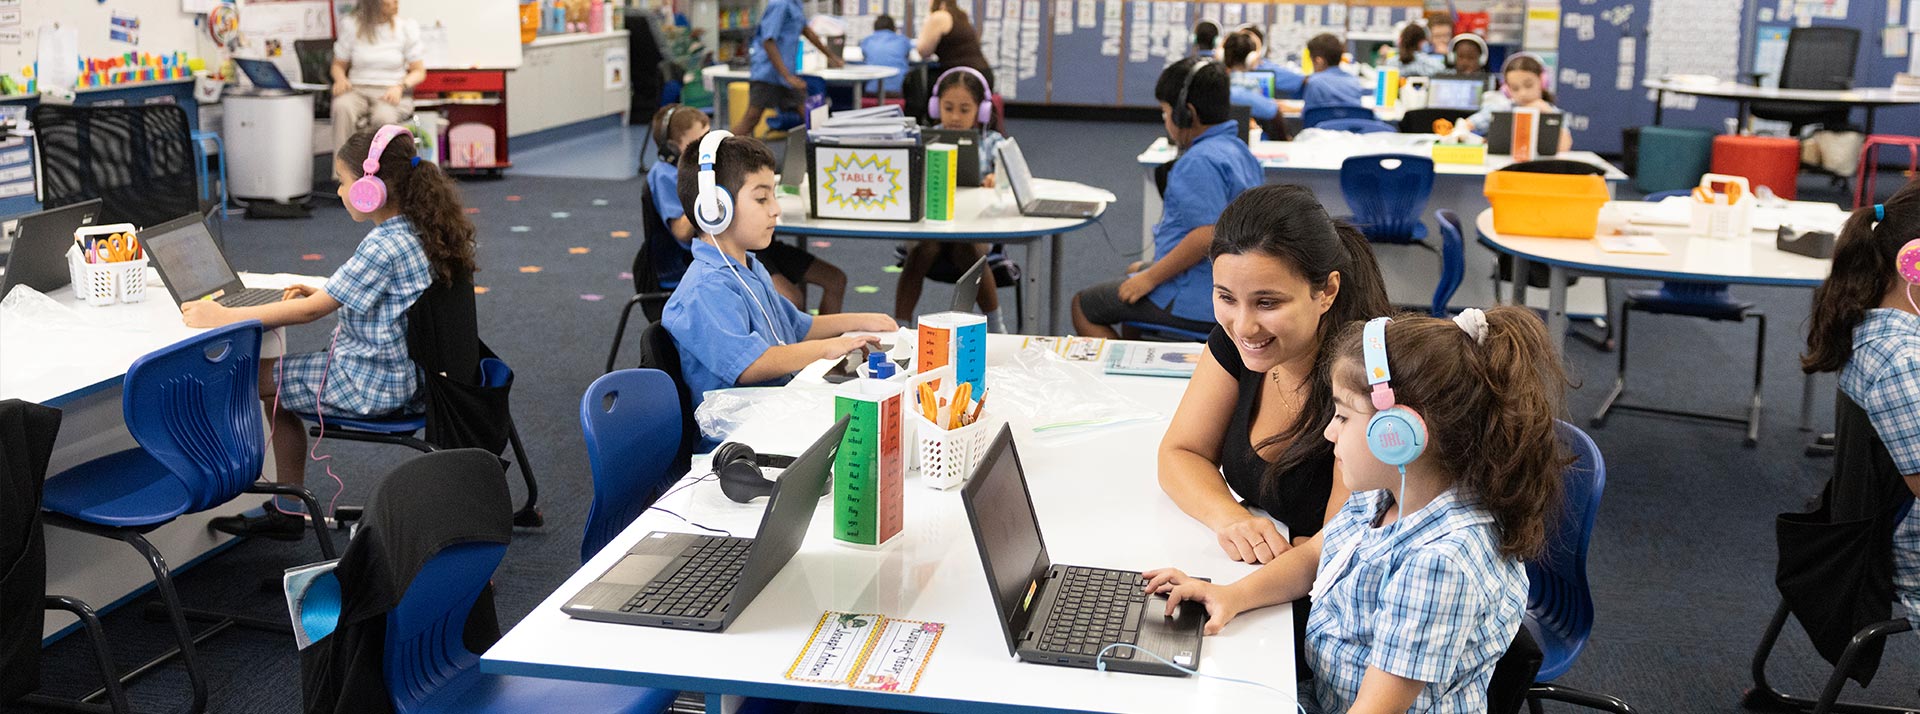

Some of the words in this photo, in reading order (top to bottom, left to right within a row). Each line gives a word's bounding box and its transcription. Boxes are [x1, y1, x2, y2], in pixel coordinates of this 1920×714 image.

[840, 172, 873, 183] TABLE
[877, 173, 884, 183] 6
[848, 436, 863, 445] school
[1378, 431, 1406, 448] JBL
[822, 628, 852, 651] Joseph
